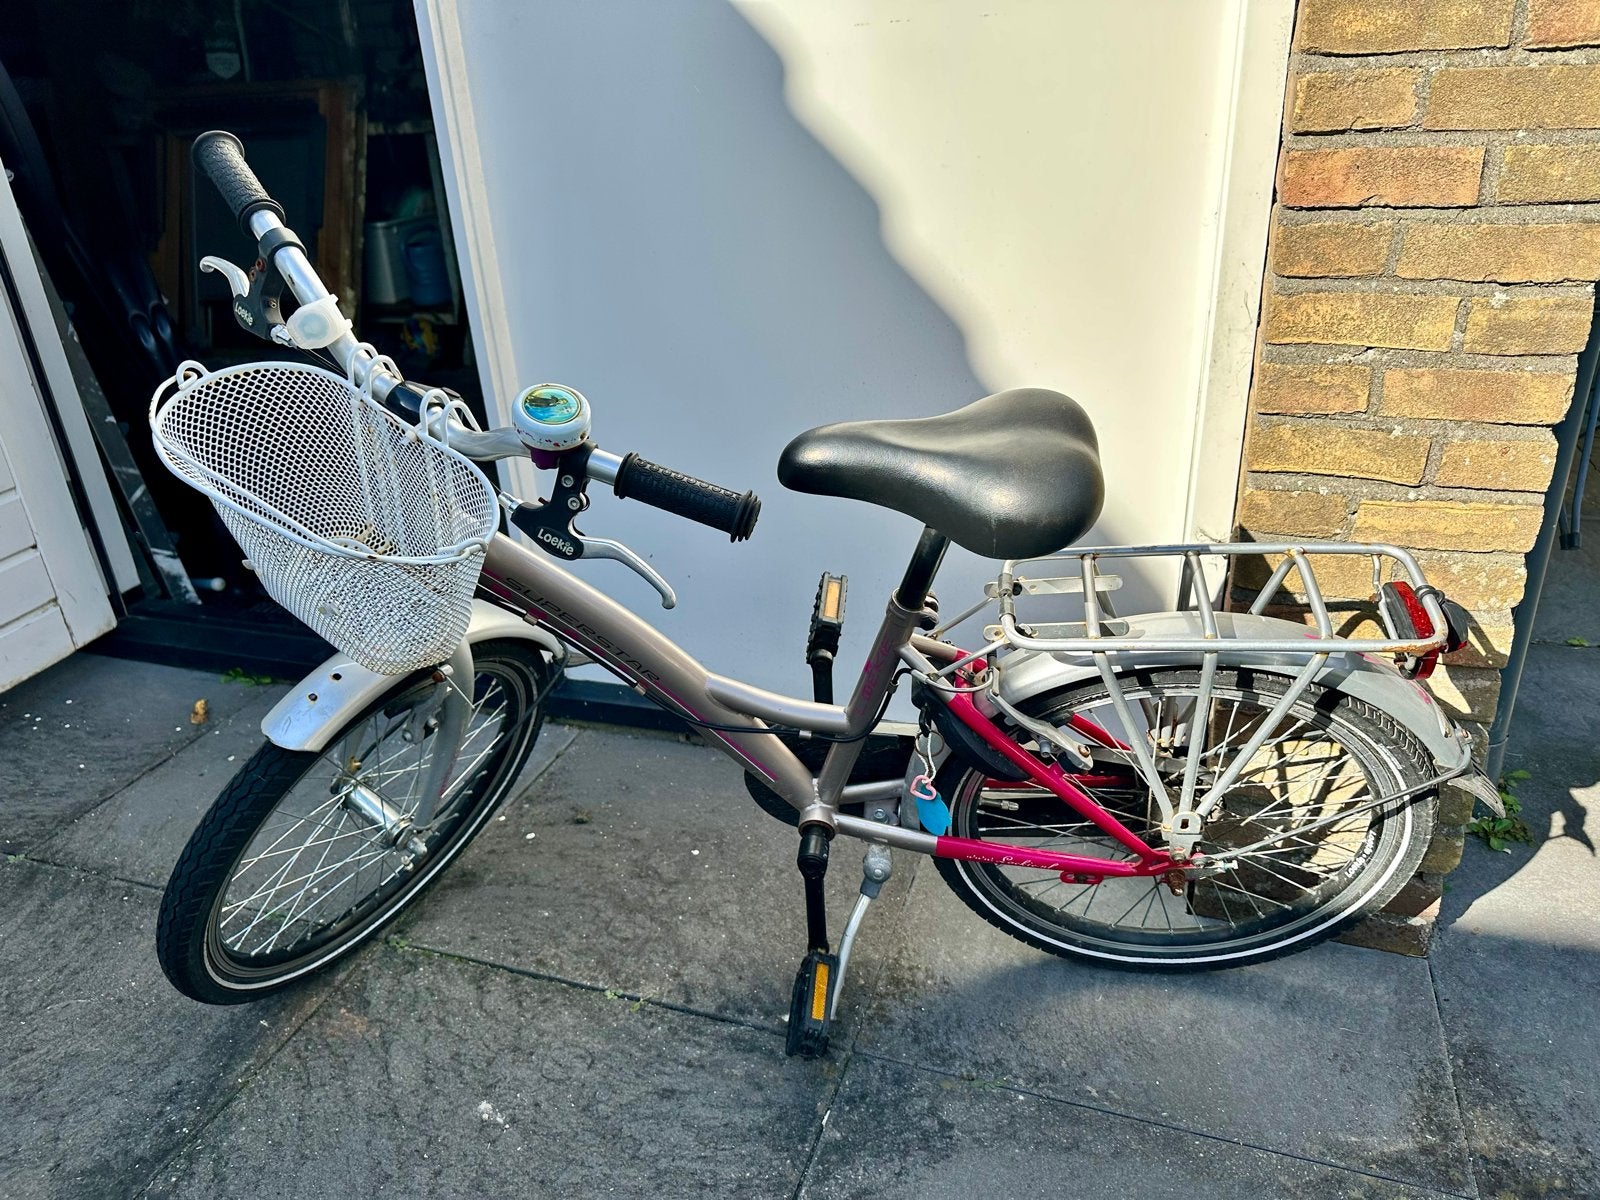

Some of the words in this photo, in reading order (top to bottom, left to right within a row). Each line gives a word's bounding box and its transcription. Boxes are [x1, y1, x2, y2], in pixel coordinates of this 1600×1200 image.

[234, 302, 254, 326] Loekie
[537, 528, 575, 556] Loekie
[504, 577, 661, 682] SUPERSTAR
